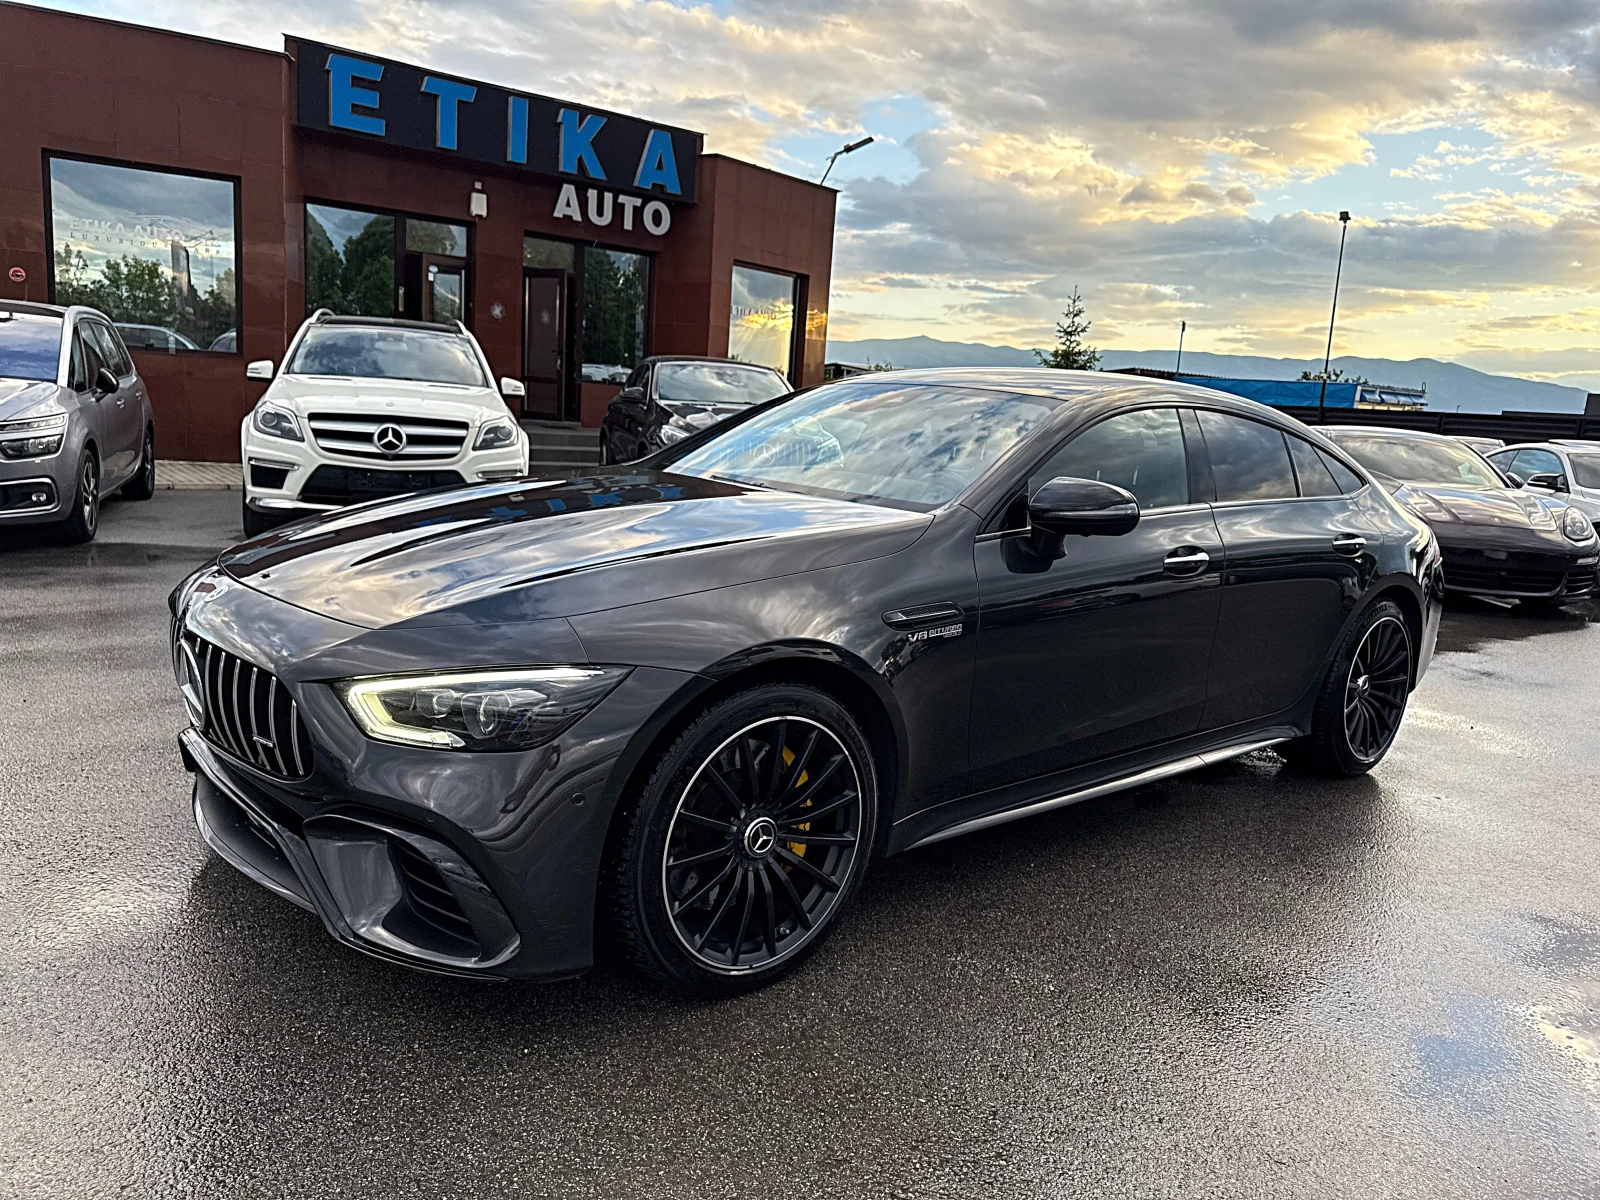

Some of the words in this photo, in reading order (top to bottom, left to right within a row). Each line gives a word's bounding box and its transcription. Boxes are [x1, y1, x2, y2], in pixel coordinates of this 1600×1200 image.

[325, 53, 682, 195] ETIKA
[553, 183, 671, 236] AUTO
[69, 217, 124, 232] ETIKA
[134, 225, 184, 241] AUTO
[908, 630, 928, 643] V8
